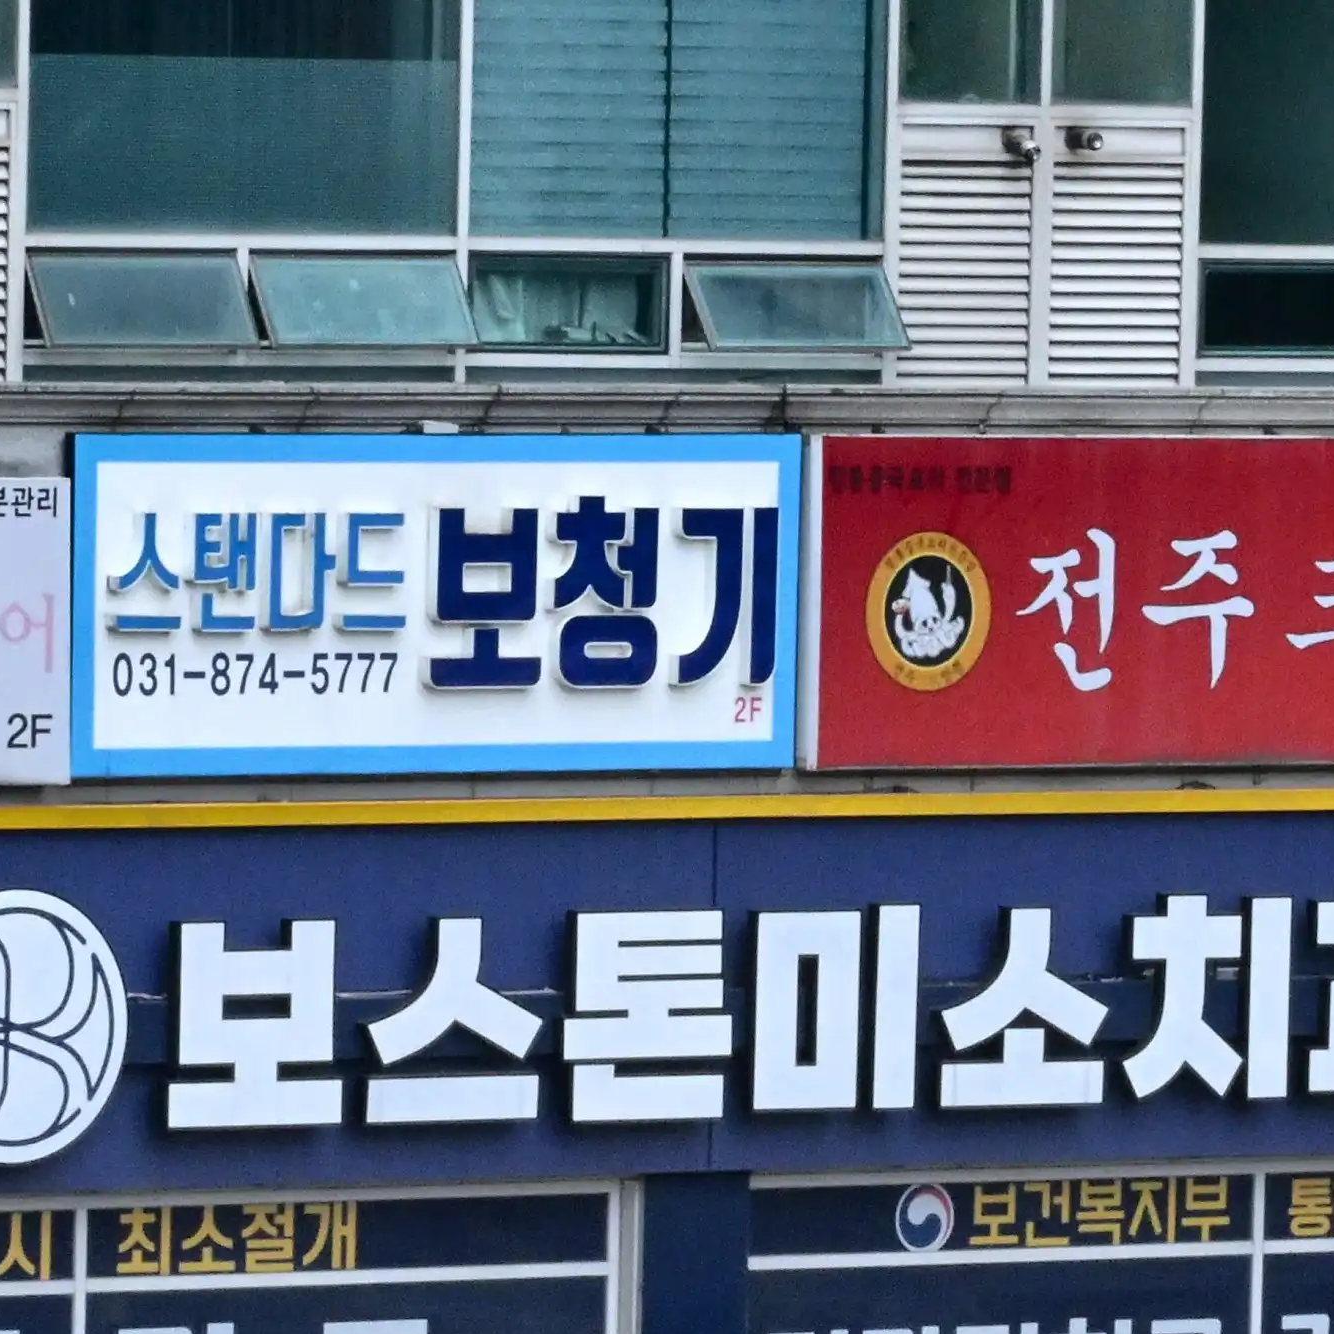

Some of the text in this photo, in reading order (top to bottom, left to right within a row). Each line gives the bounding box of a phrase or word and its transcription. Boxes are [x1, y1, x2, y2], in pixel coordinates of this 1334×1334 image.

[106, 496, 779, 690] 스탠다드 보청기
[1015, 526, 1255, 692] 전주
[112, 651, 400, 696] 031-874-5777
[733, 697, 762, 724] 2F
[6, 713, 54, 751] 2F
[114, 1201, 360, 1277] 최소절개
[967, 1174, 1233, 1251] 보건복지부
